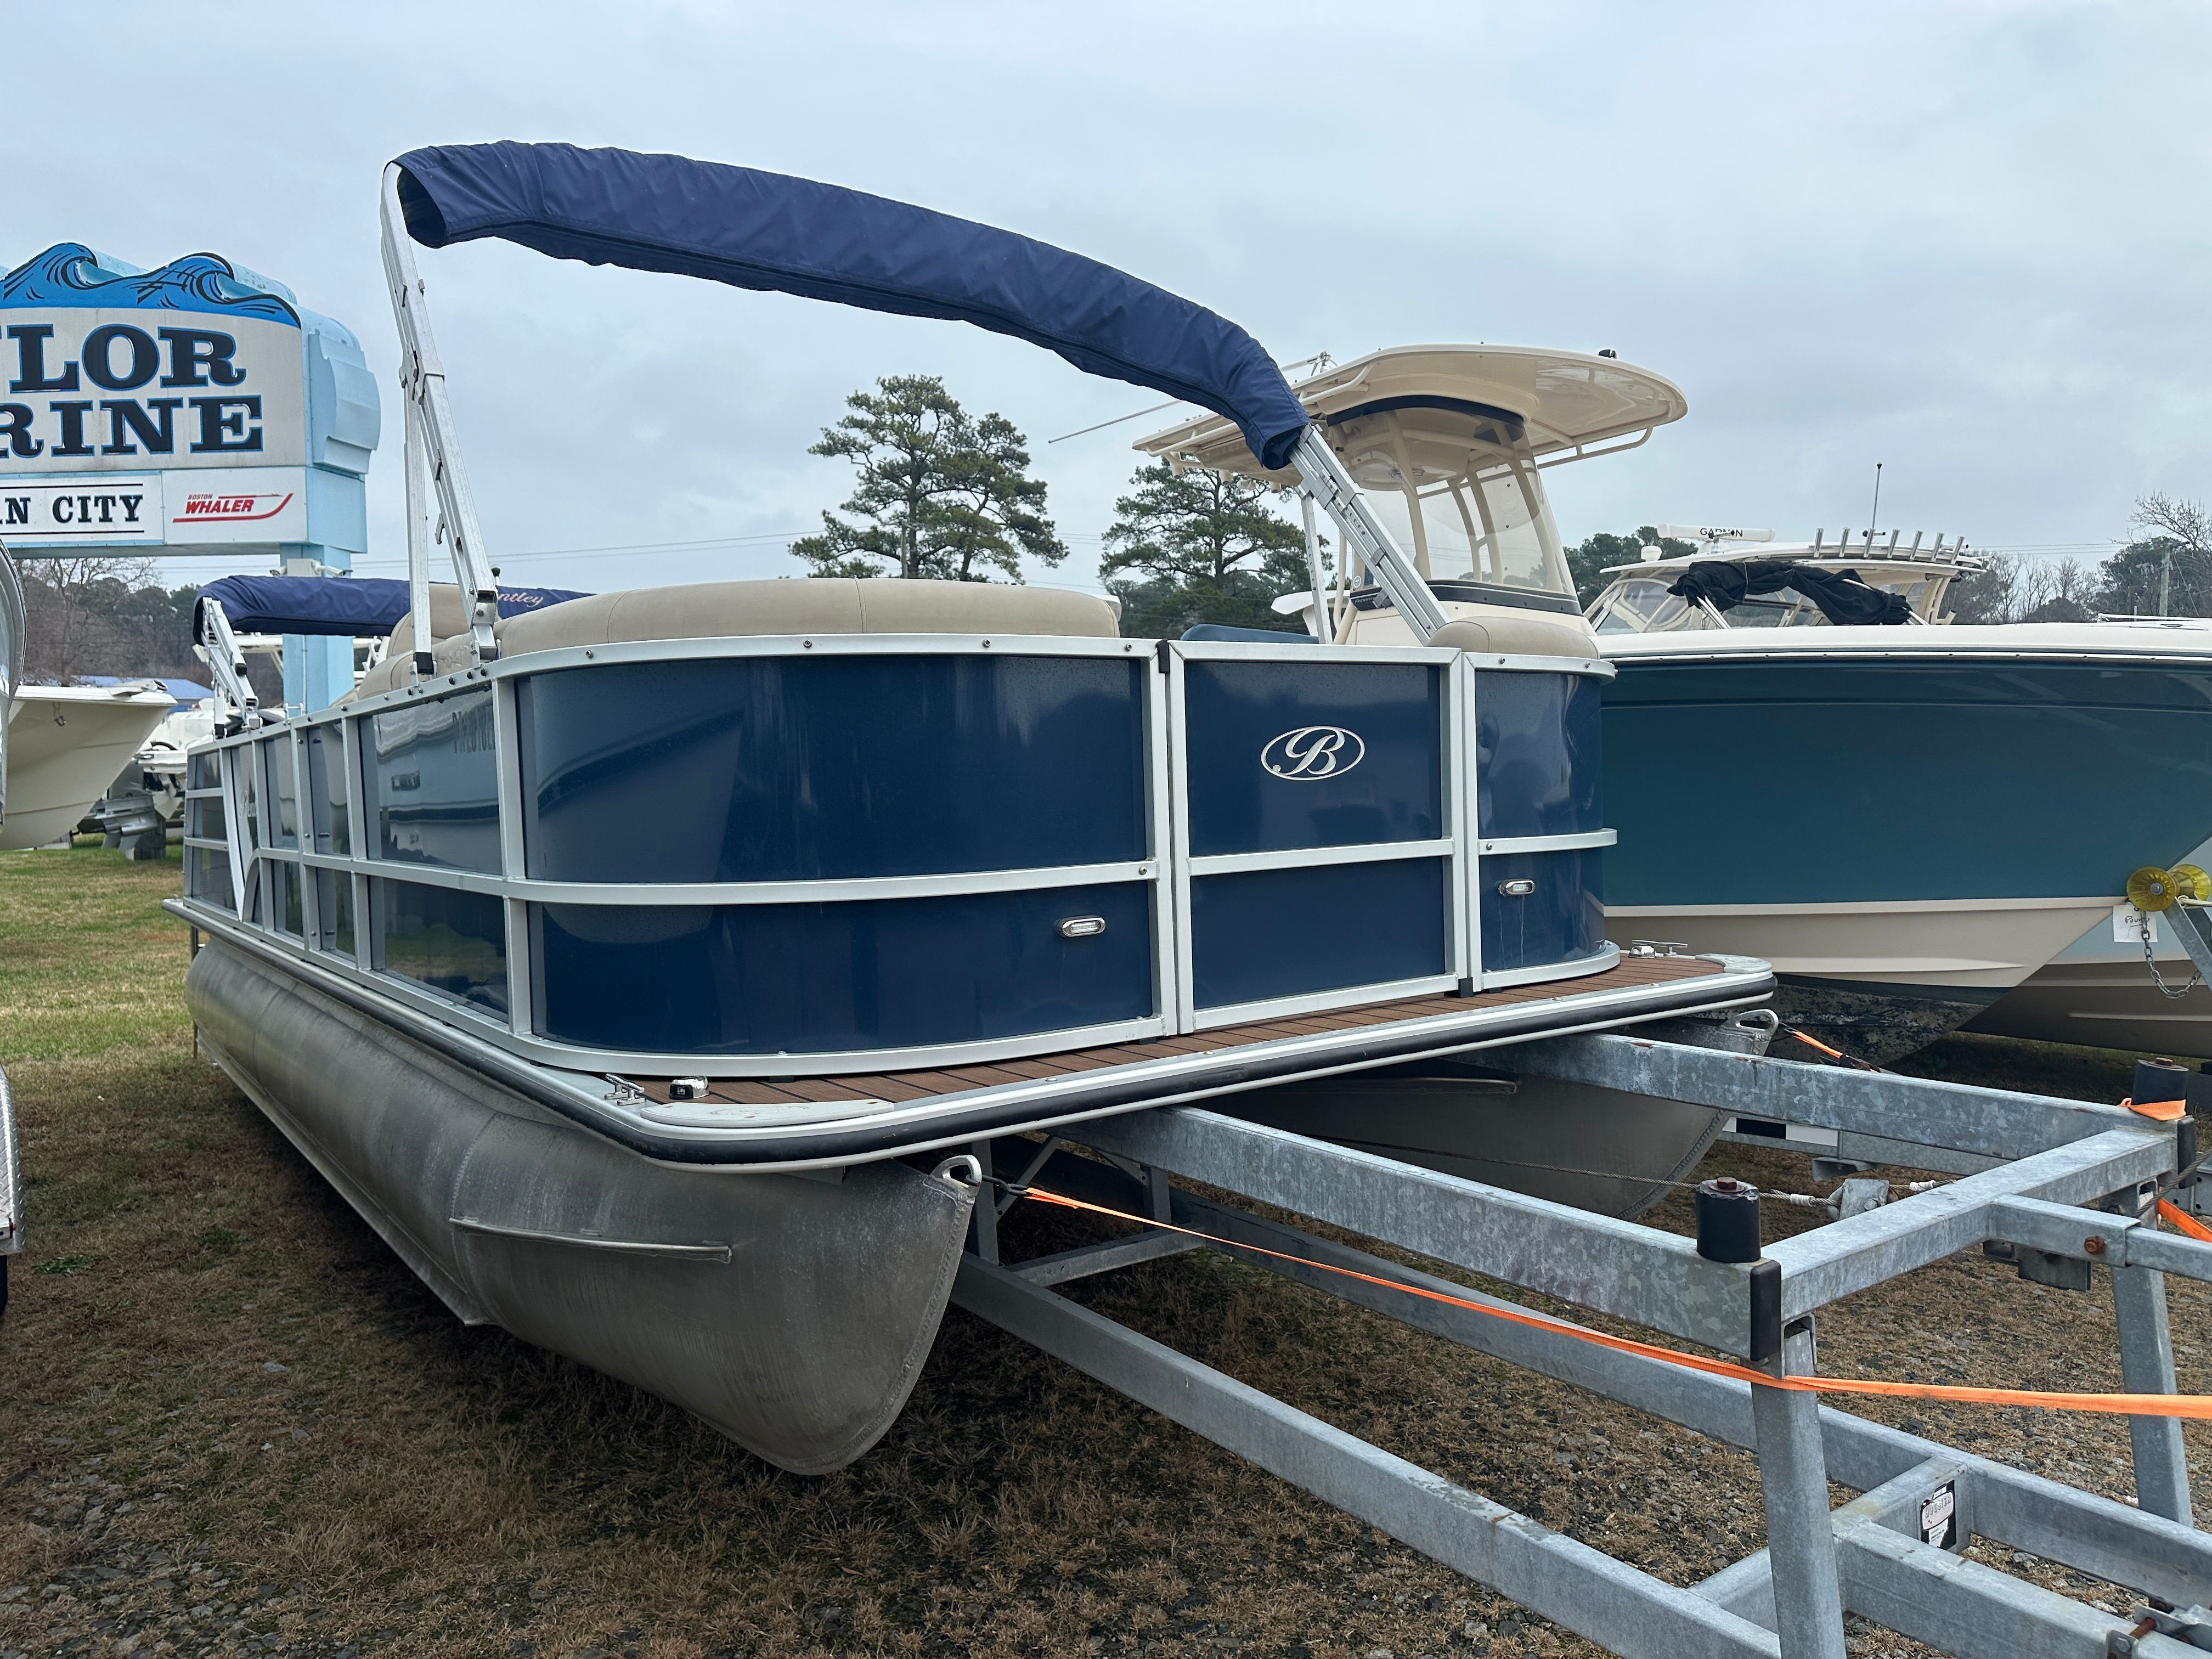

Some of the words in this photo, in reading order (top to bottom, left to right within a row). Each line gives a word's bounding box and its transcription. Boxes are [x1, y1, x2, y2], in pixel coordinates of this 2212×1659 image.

[0, 324, 246, 394] LOR
[52, 494, 144, 524] CITY
[185, 499, 255, 514] WHALER
[1272, 726, 1346, 776] B
